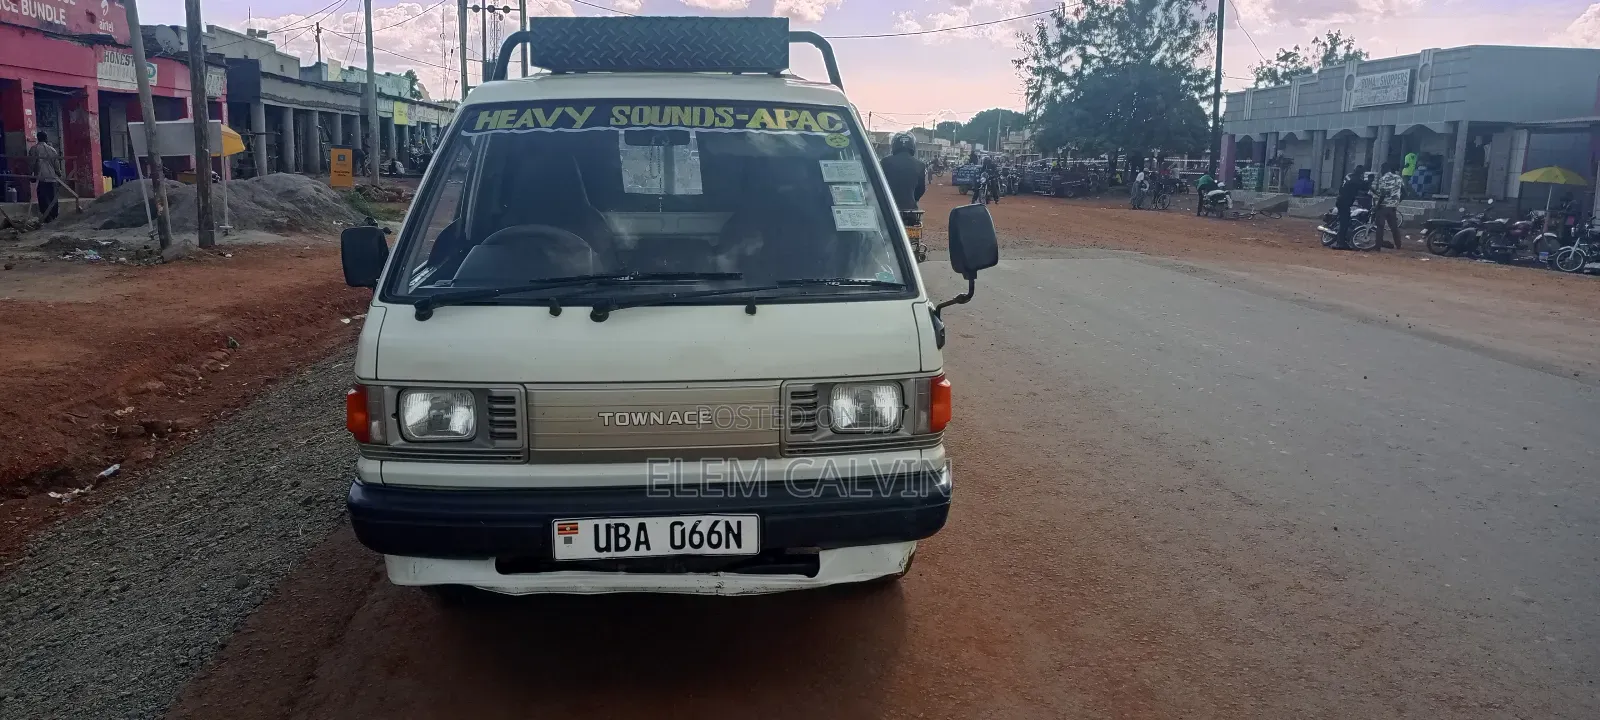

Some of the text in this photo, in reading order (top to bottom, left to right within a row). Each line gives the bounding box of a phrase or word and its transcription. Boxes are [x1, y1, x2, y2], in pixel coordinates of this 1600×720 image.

[0, 0, 66, 26] CE BUNDLE
[98, 18, 114, 33] airtel
[104, 50, 135, 67] HONEST
[474, 106, 596, 131] HEAVY
[593, 519, 743, 553] UBA 066N
